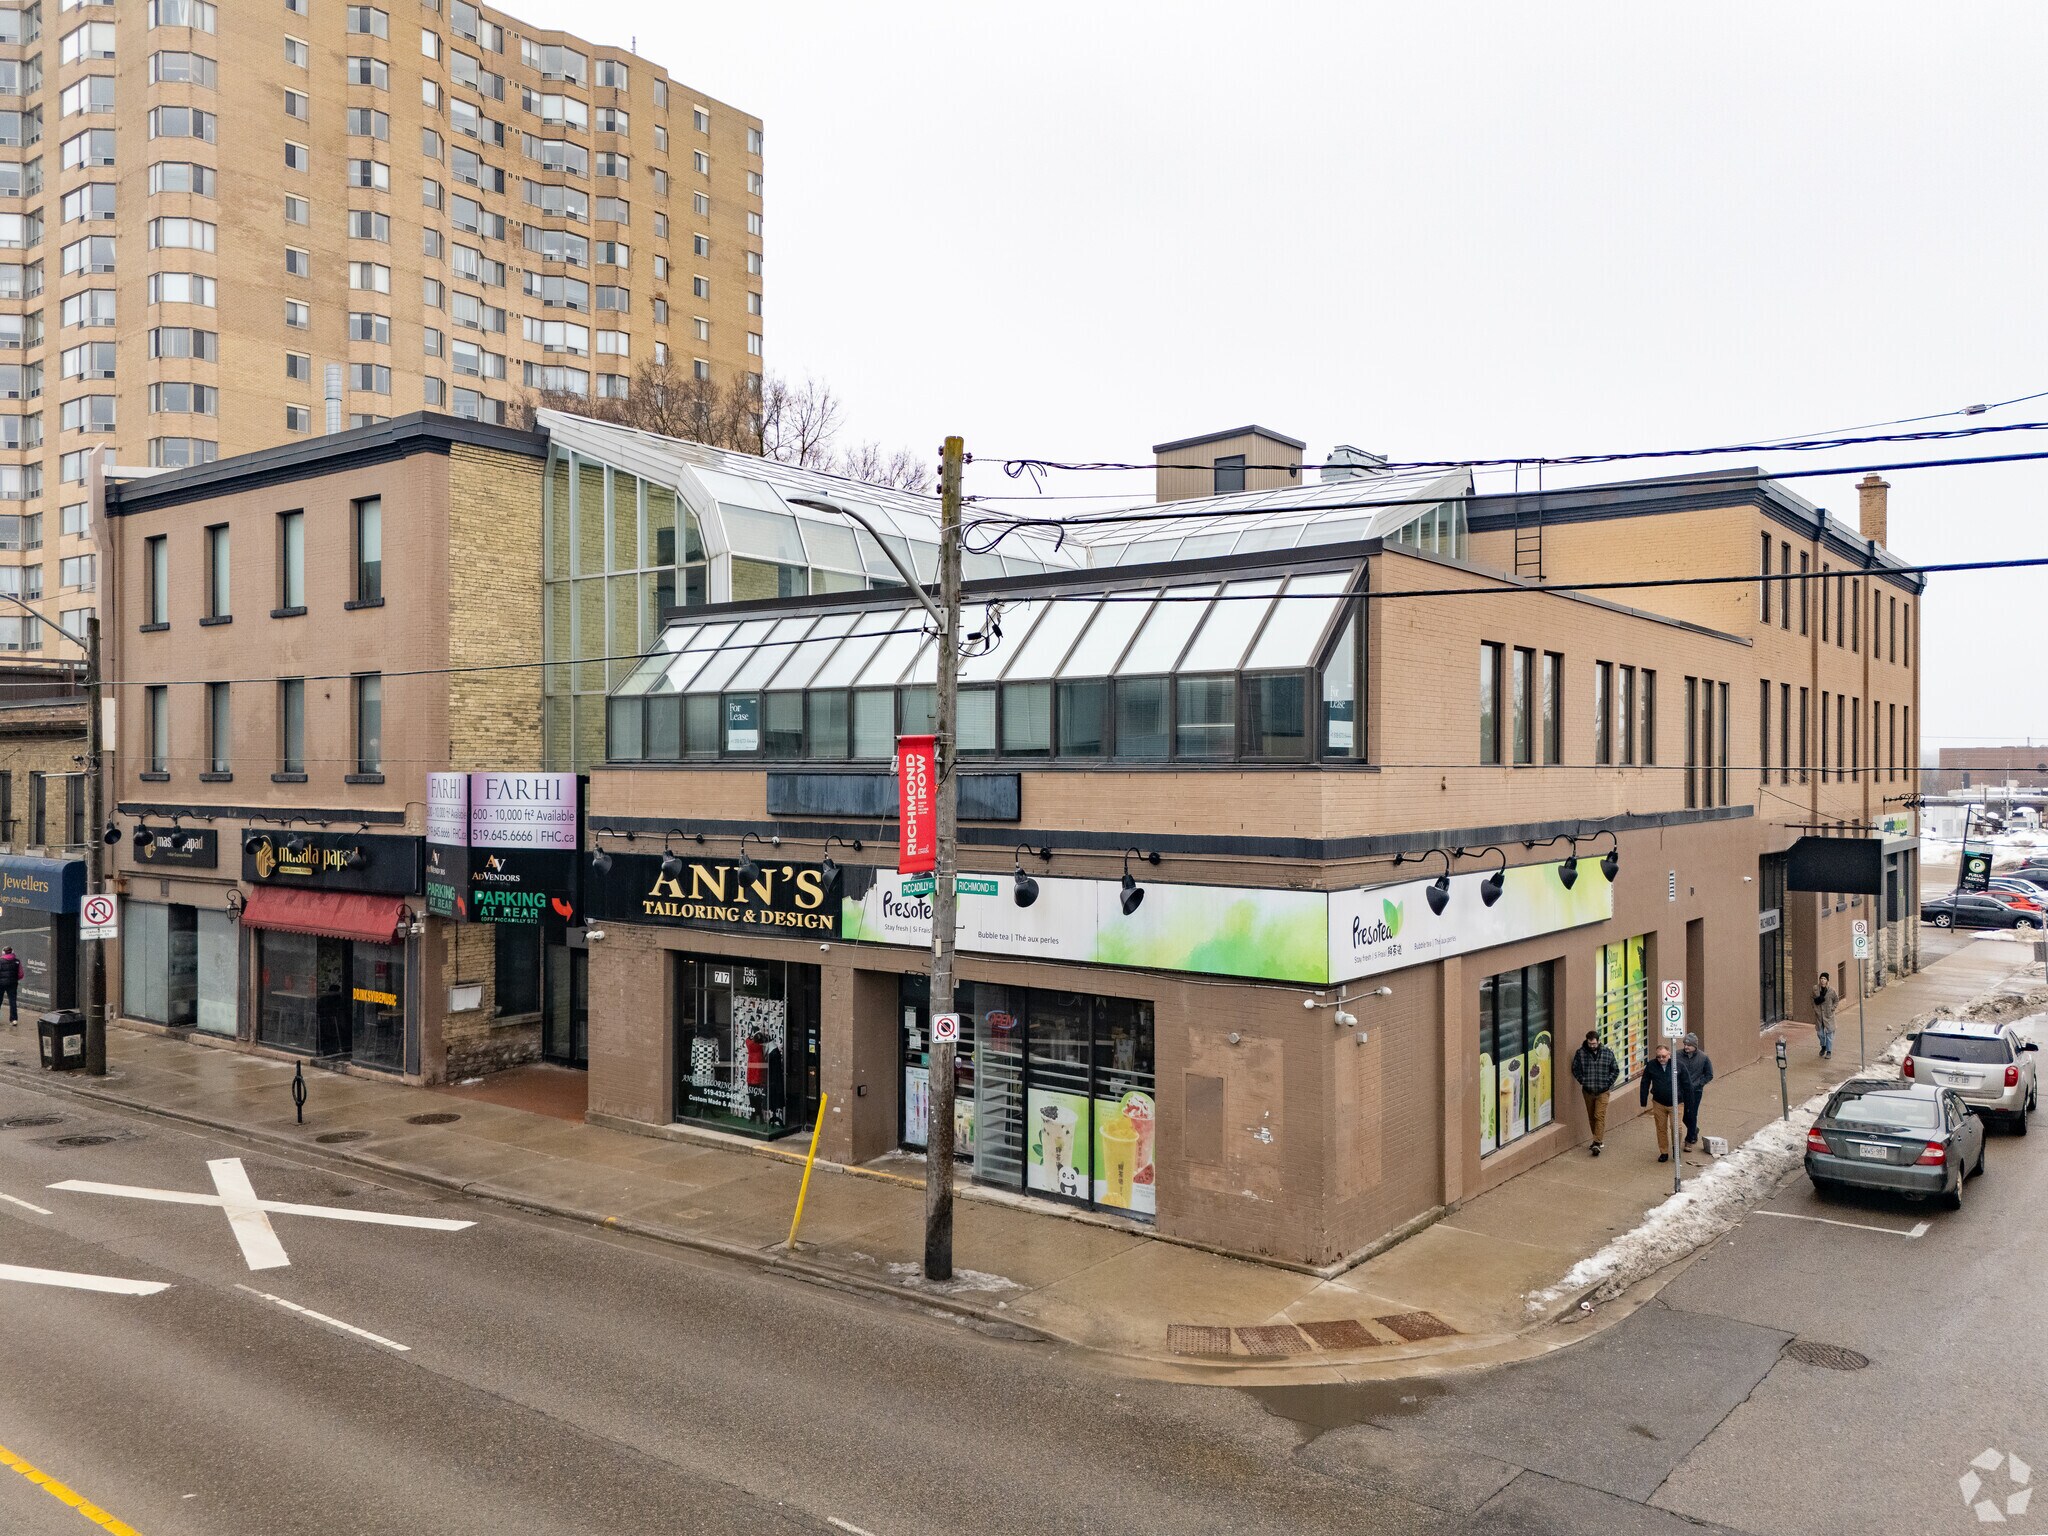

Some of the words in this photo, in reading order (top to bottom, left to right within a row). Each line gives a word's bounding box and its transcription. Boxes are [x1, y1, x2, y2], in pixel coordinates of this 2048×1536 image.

[729, 702, 742, 712] For
[1330, 697, 1346, 709] Lease
[729, 711, 749, 721] Lease
[916, 754, 927, 800] ROW
[431, 778, 461, 800] FARHI
[485, 779, 562, 800] FARHI
[906, 753, 917, 856] RICHMOND
[473, 809, 488, 820] 600
[496, 809, 522, 822] 10,000
[524, 809, 535, 821] ft²
[536, 810, 575, 822] Available
[157, 835, 177, 849] mas
[473, 829, 533, 842] 519.645.6666
[541, 831, 575, 844] FHC.ca
[3, 872, 49, 893] Jewellers
[648, 864, 824, 909] ANN'S
[903, 881, 929, 894] PICCADILLY
[958, 881, 989, 892] RICHMOND
[427, 881, 456, 901] PARKING
[429, 896, 436, 907] AT
[437, 898, 453, 911] REAR
[474, 890, 546, 908] PARKING
[480, 907, 496, 917] AT
[503, 907, 539, 919] REAR
[643, 900, 740, 922] TAILORING
[743, 909, 757, 923] &
[759, 910, 834, 930] DESIGN
[885, 923, 895, 931] Stay
[896, 924, 908, 932] fresh
[1353, 915, 1393, 949] Presotea
[978, 931, 998, 939] Bubble
[1015, 933, 1026, 942] Thé
[1040, 937, 1059, 945] perles
[1414, 942, 1425, 950] Bubble
[1362, 953, 1371, 961] fresh
[1607, 948, 1618, 966] Stay
[715, 972, 729, 983] 717
[743, 966, 756, 977] Est.
[1610, 964, 1622, 979] Fresh
[743, 976, 757, 986] 1991
[988, 1012, 1015, 1028] OPEN
[688, 1094, 708, 1103] Custom
[708, 1098, 721, 1106] Made
